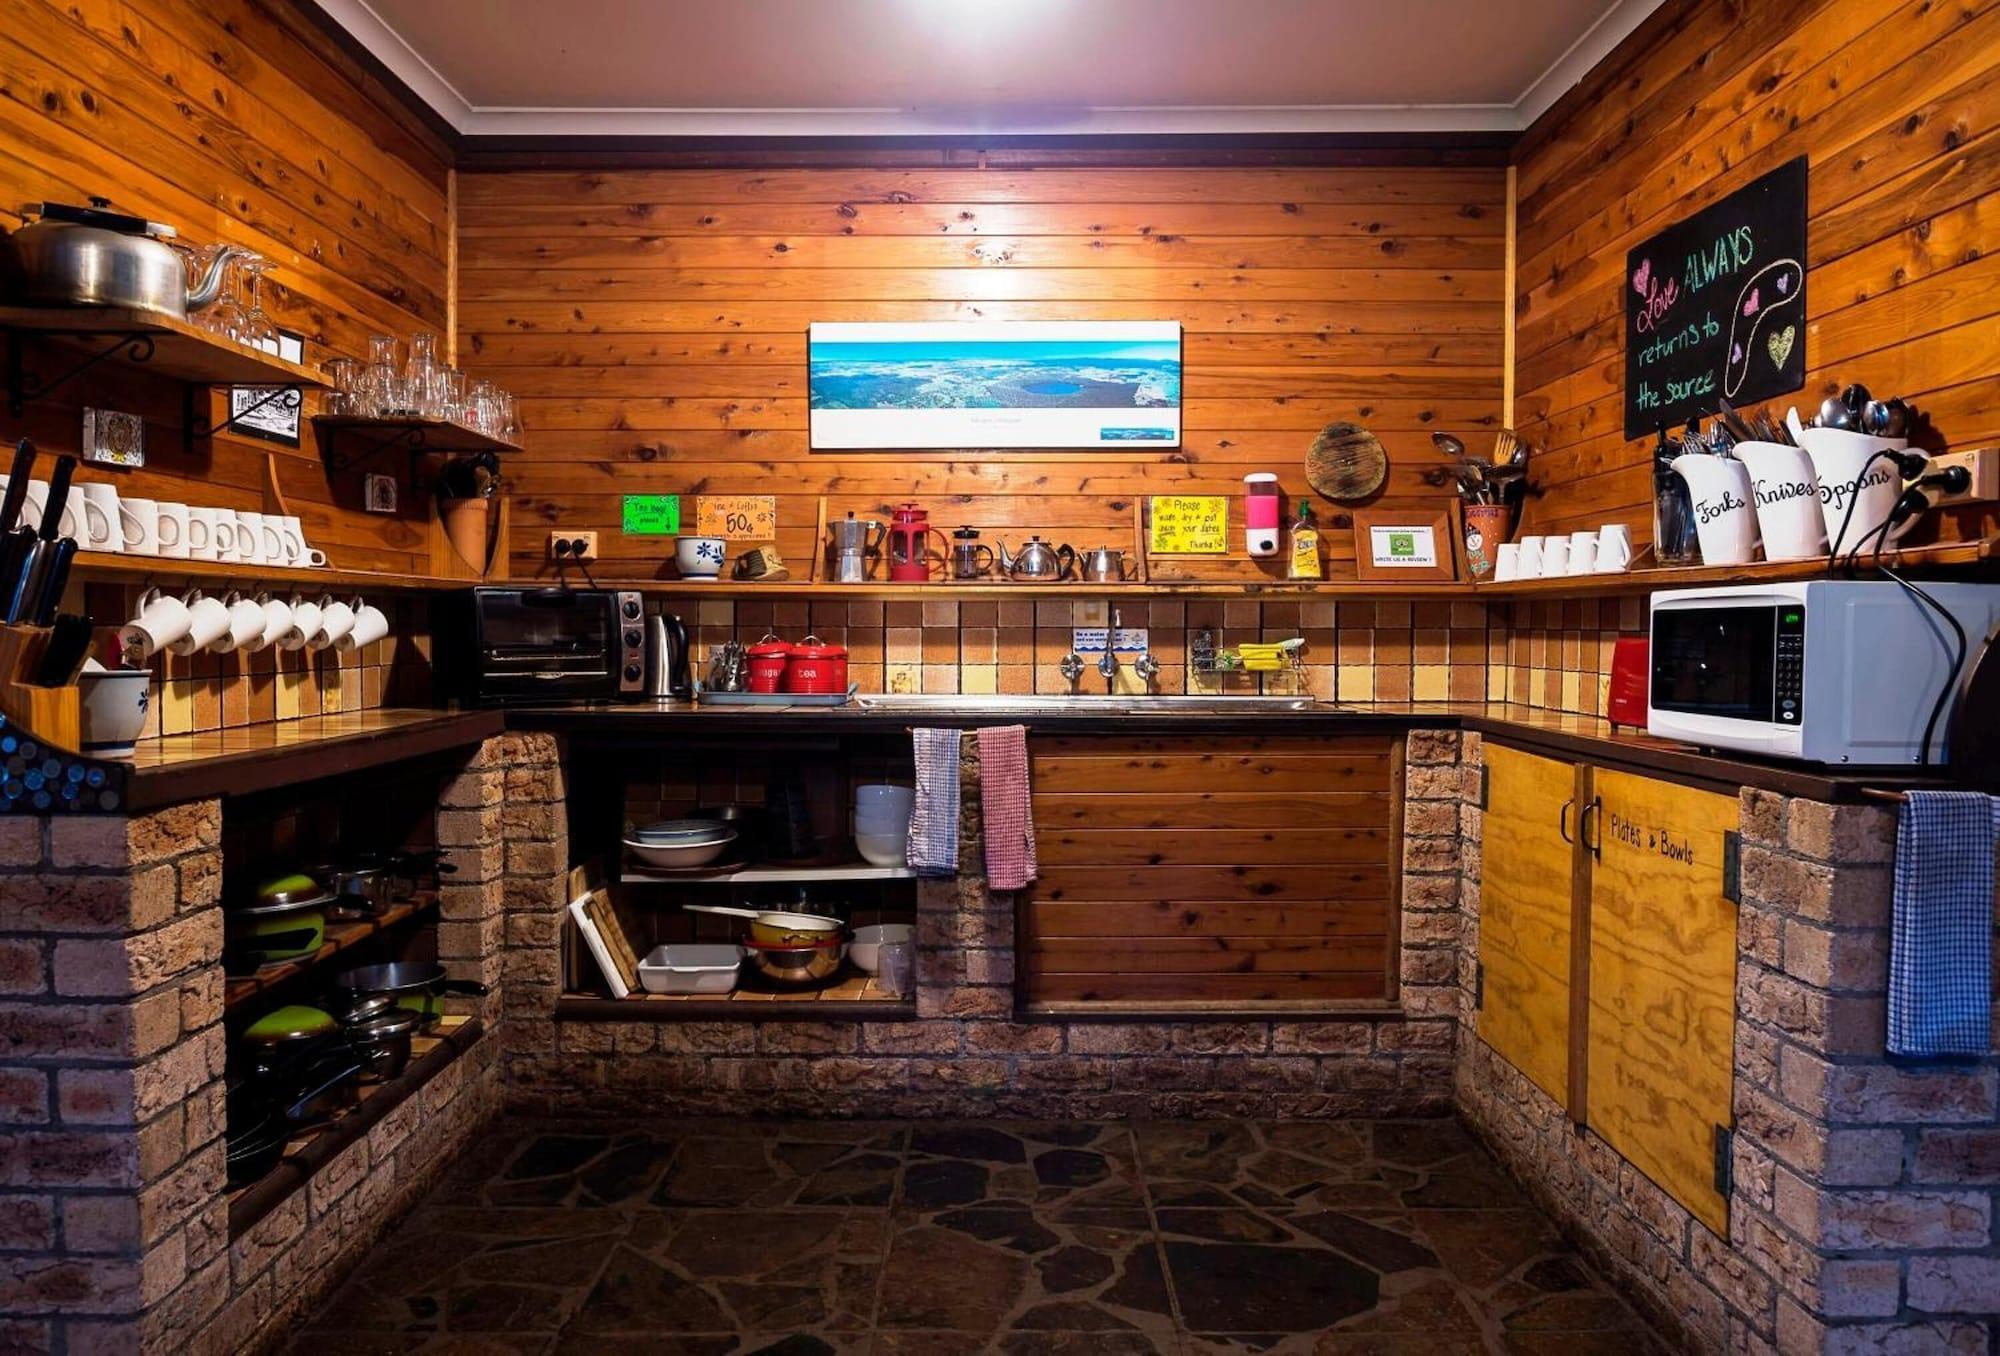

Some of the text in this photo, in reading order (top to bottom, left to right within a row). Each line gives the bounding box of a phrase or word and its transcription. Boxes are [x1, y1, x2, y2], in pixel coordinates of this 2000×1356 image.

[1683, 225, 1754, 294] ALWAYS
[1637, 311, 1720, 368] returns to
[1635, 369, 1716, 410] the source
[1174, 500, 1200, 511] Please
[1695, 491, 1745, 524] Forks
[1752, 479, 1816, 508] Knives
[1816, 470, 1890, 509] Spoons
[1611, 813, 1641, 848] Plates
[1661, 830, 1694, 866] Bowls
